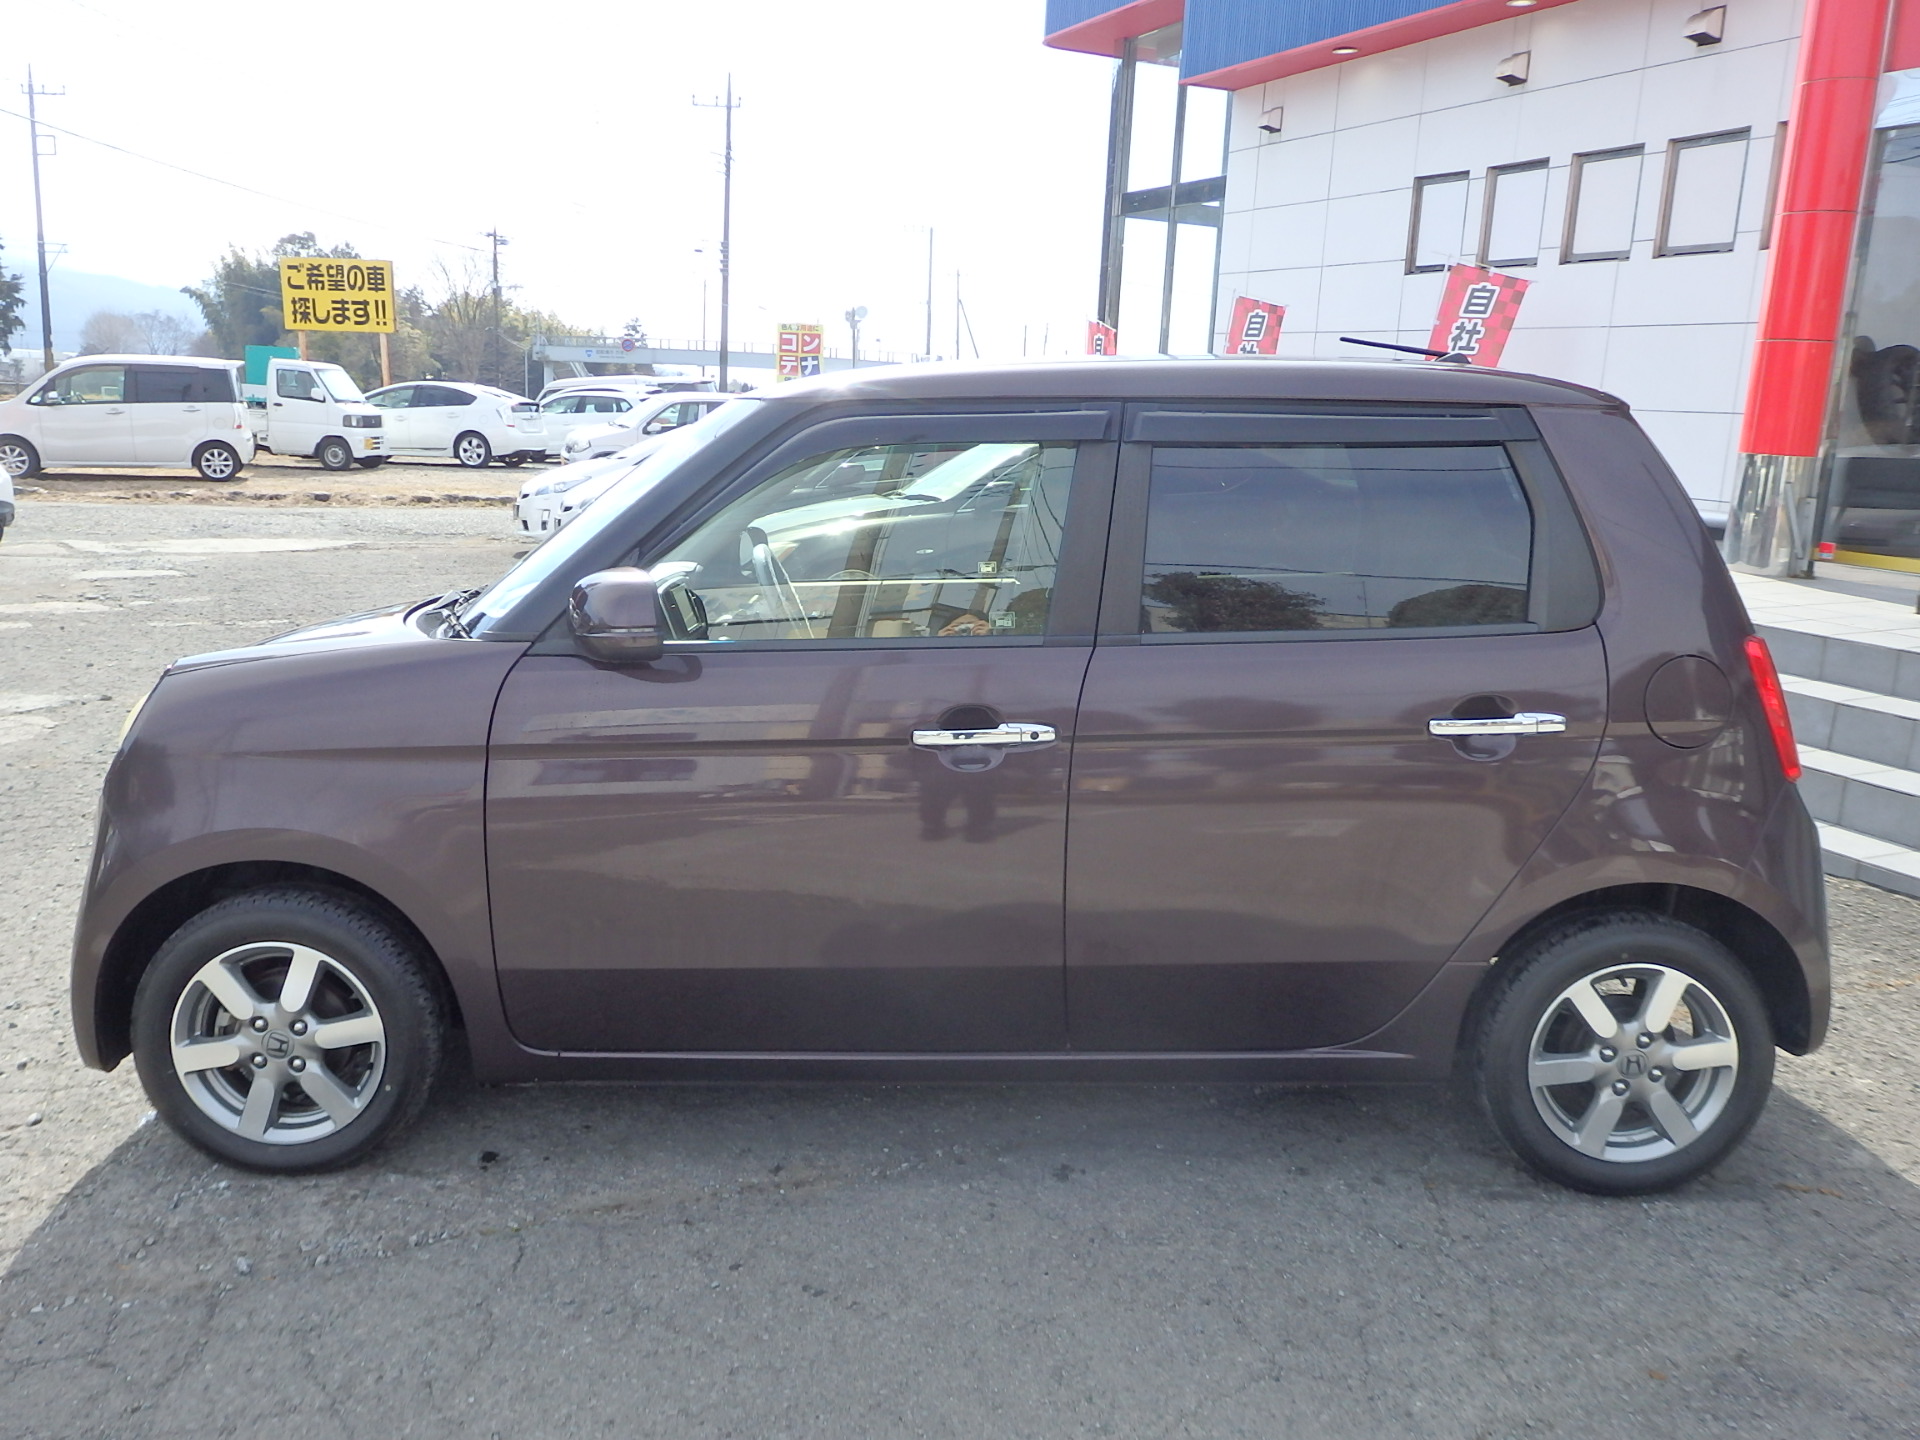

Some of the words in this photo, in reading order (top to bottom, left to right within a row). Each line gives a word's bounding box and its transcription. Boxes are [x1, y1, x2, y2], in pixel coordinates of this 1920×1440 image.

[287, 263, 386, 292] ご希望の車
[1450, 284, 1497, 352] 自社
[781, 333, 820, 352] コン
[780, 355, 819, 376] テナ
